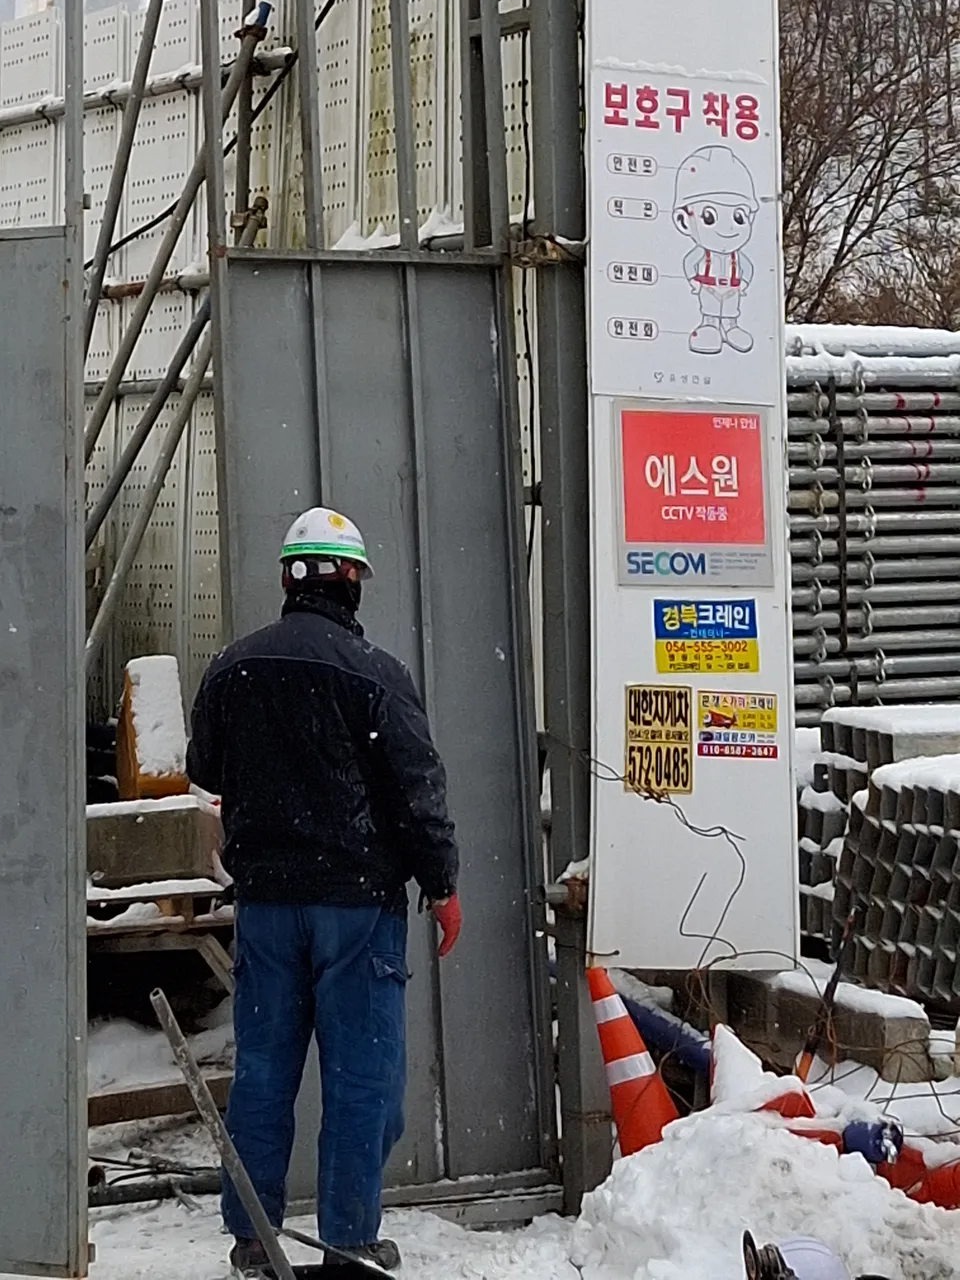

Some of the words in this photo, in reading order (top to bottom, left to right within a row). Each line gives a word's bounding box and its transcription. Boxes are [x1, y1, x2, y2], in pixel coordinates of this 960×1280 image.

[603, 82, 691, 134] 보호구
[701, 91, 760, 142] 착용
[644, 455, 739, 498] 에스원
[661, 506, 694, 521] CCTV
[626, 552, 706, 576] SECOM
[662, 604, 750, 630] 경북크레인
[665, 640, 748, 653] 054-555-3002
[628, 689, 689, 728] 대한지게차
